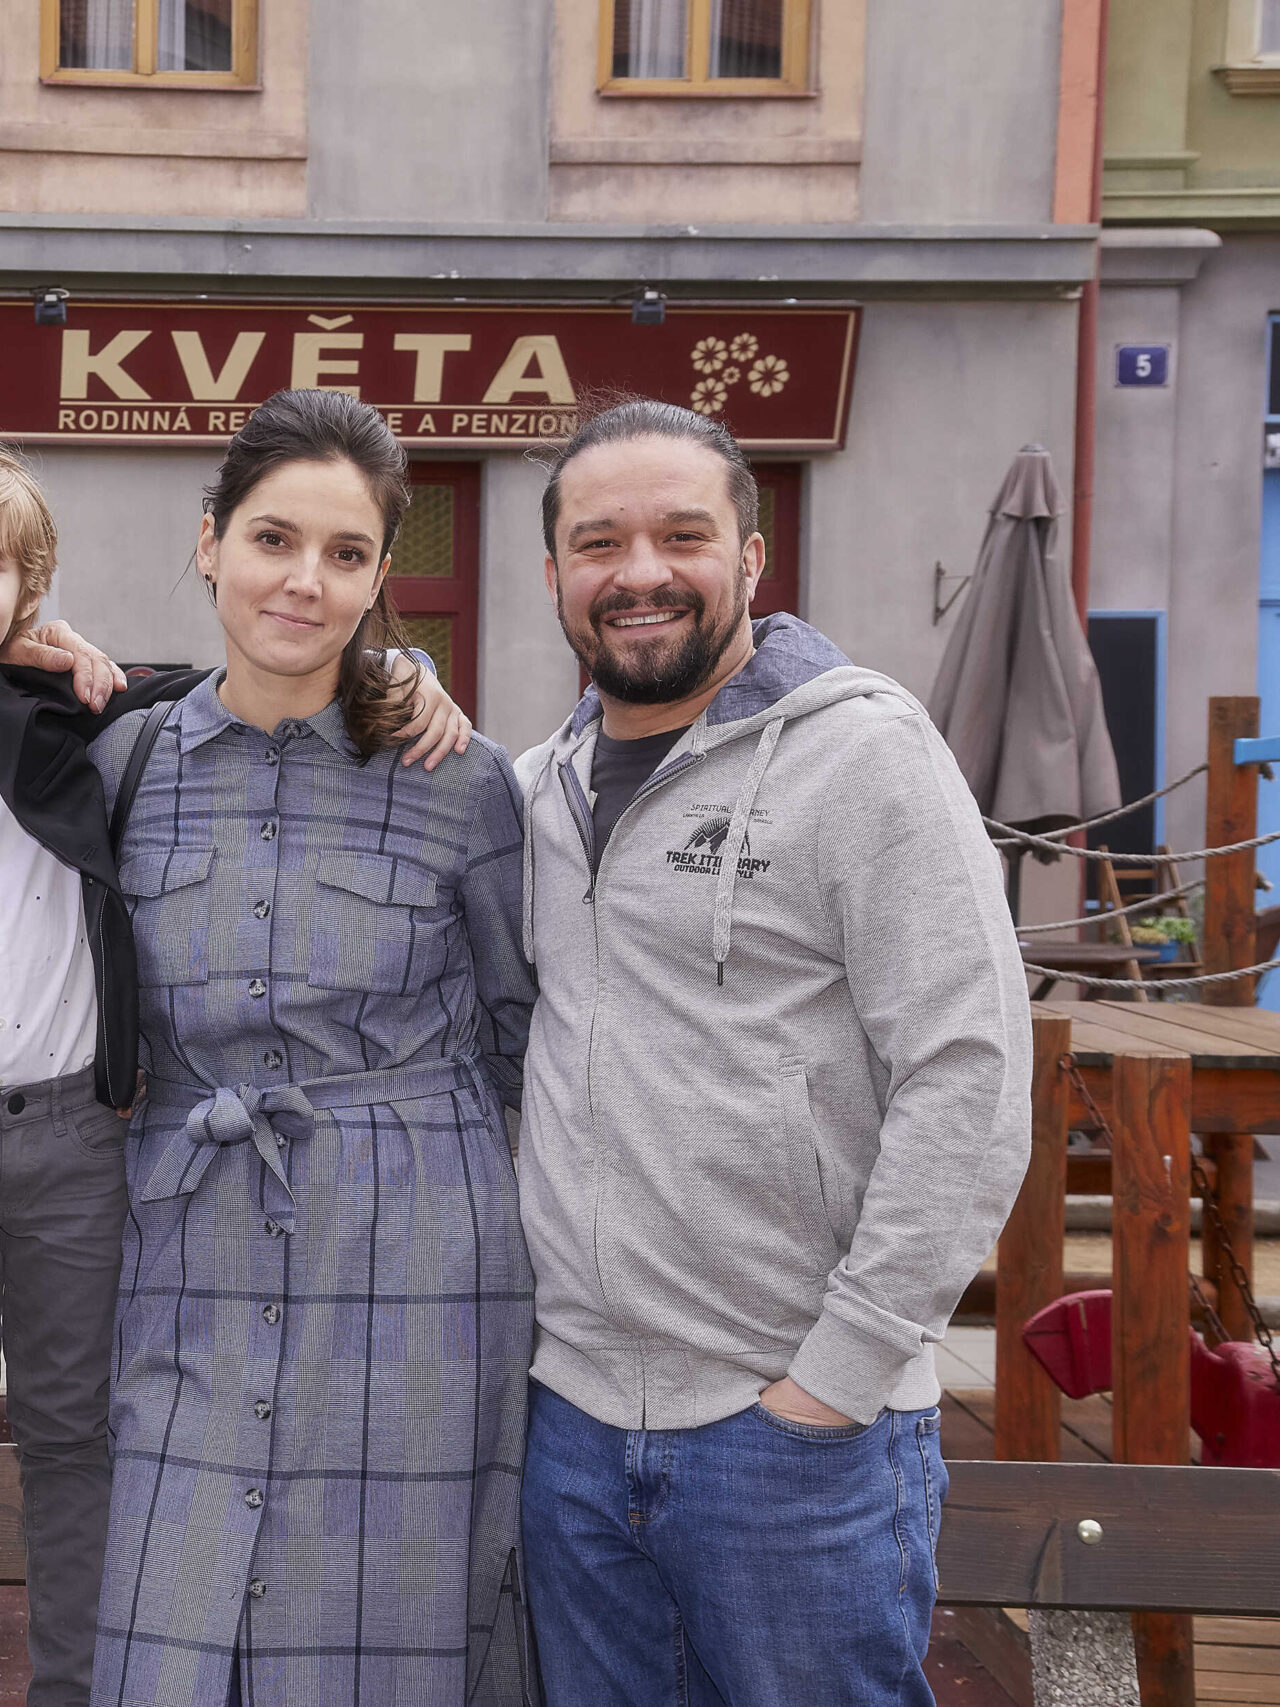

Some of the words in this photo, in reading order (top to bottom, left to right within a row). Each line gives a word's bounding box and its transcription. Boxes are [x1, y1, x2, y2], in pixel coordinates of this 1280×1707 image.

[60, 314, 577, 404] KVĚTA
[1135, 353, 1152, 377] 5
[58, 406, 192, 432] RODINNÁ
[417, 414, 437, 434] A
[451, 412, 578, 436] PENZION
[690, 804, 733, 814] SPIRITUAL
[666, 850, 698, 865] TREK
[673, 864, 712, 875] OUTDOOR
